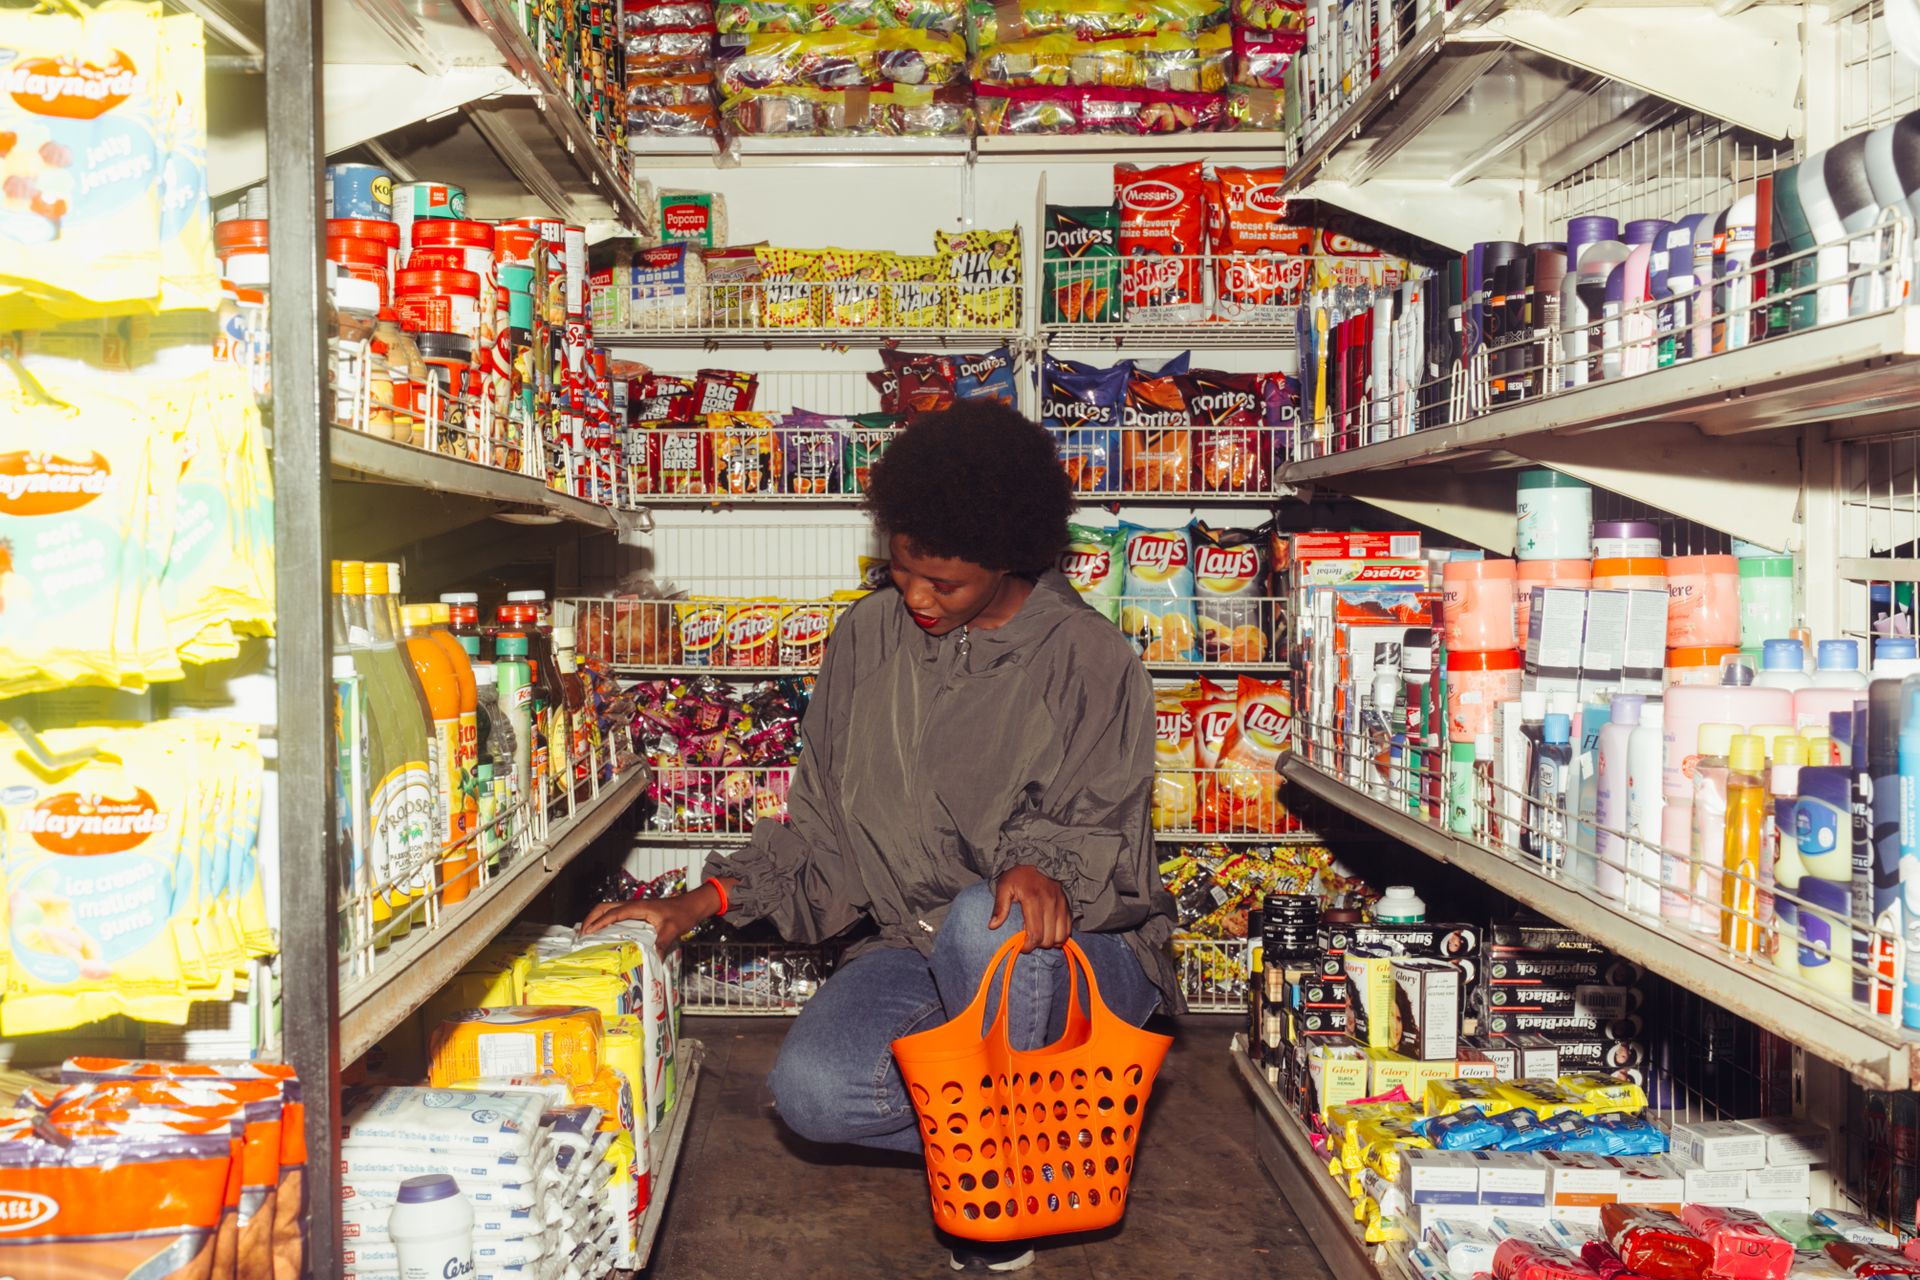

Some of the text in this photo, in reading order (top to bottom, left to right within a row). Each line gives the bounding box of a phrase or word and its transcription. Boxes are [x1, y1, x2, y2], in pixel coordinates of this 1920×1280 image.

[0, 66, 146, 101] Maynards
[1127, 188, 1176, 202] Messaris
[1253, 192, 1284, 203] Mess
[667, 213, 705, 227] Popcorn
[1230, 221, 1263, 230] Cheese
[1045, 228, 1113, 249] Doritos
[1143, 229, 1170, 237] Snack
[1270, 231, 1298, 240] Snack
[644, 251, 678, 263] opcorn
[950, 250, 993, 278] NIK
[591, 274, 610, 286] corn
[959, 267, 1017, 295] NAKS
[898, 290, 941, 312] NAKS
[960, 358, 1007, 378] Doritos
[706, 382, 739, 401] BIG
[702, 397, 735, 411] KORN
[1042, 399, 1111, 423] Doritos
[1191, 391, 1256, 416] Doritos
[1123, 407, 1190, 427] Doritos
[0, 470, 119, 500] aynards
[1130, 536, 1186, 573] Lay's
[1195, 547, 1255, 580] Lay's
[1316, 567, 1342, 576] Herbal
[1362, 567, 1426, 580] Colgate
[1668, 584, 1693, 597] lere
[727, 615, 774, 644] Fritos
[782, 613, 829, 640] Fritos
[1155, 711, 1193, 745] ay's
[1246, 704, 1291, 745] Lay
[18, 808, 168, 838] Maynards
[98, 863, 156, 893] cream
[1395, 970, 1417, 985] Glory
[1515, 963, 1598, 976] SuperBlack
[1515, 1017, 1598, 1030] SuperBlack
[1492, 1054, 1512, 1064] lory
[1331, 1065, 1361, 1077] Glory
[1381, 1066, 1410, 1077] Glory
[1420, 1068, 1450, 1079] Glory
[1462, 1068, 1491, 1078] Glory
[1737, 1241, 1772, 1258] LUX
[443, 1256, 475, 1279] Cere
